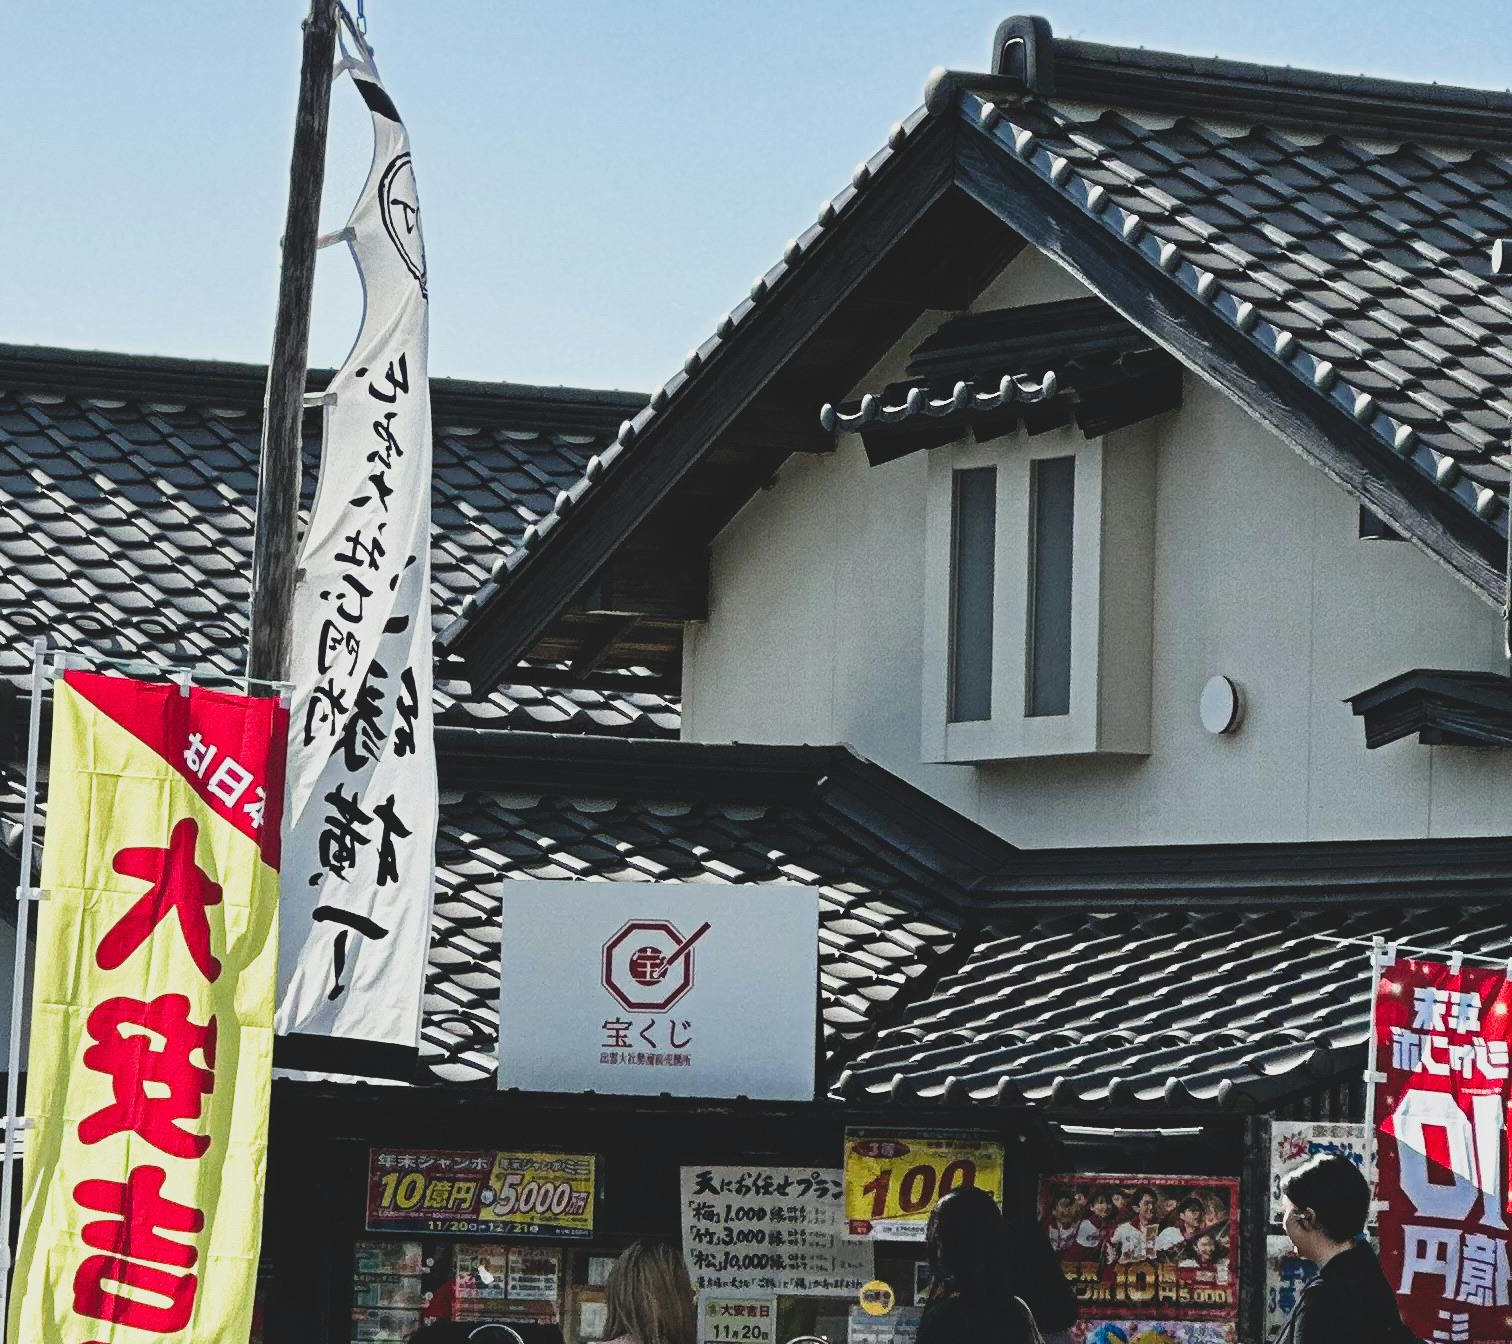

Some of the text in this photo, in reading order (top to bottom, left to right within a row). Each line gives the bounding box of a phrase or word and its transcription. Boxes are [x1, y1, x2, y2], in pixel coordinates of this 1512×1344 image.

[601, 1017, 693, 1049] 宝くじ
[380, 1171, 478, 1211] 10億円
